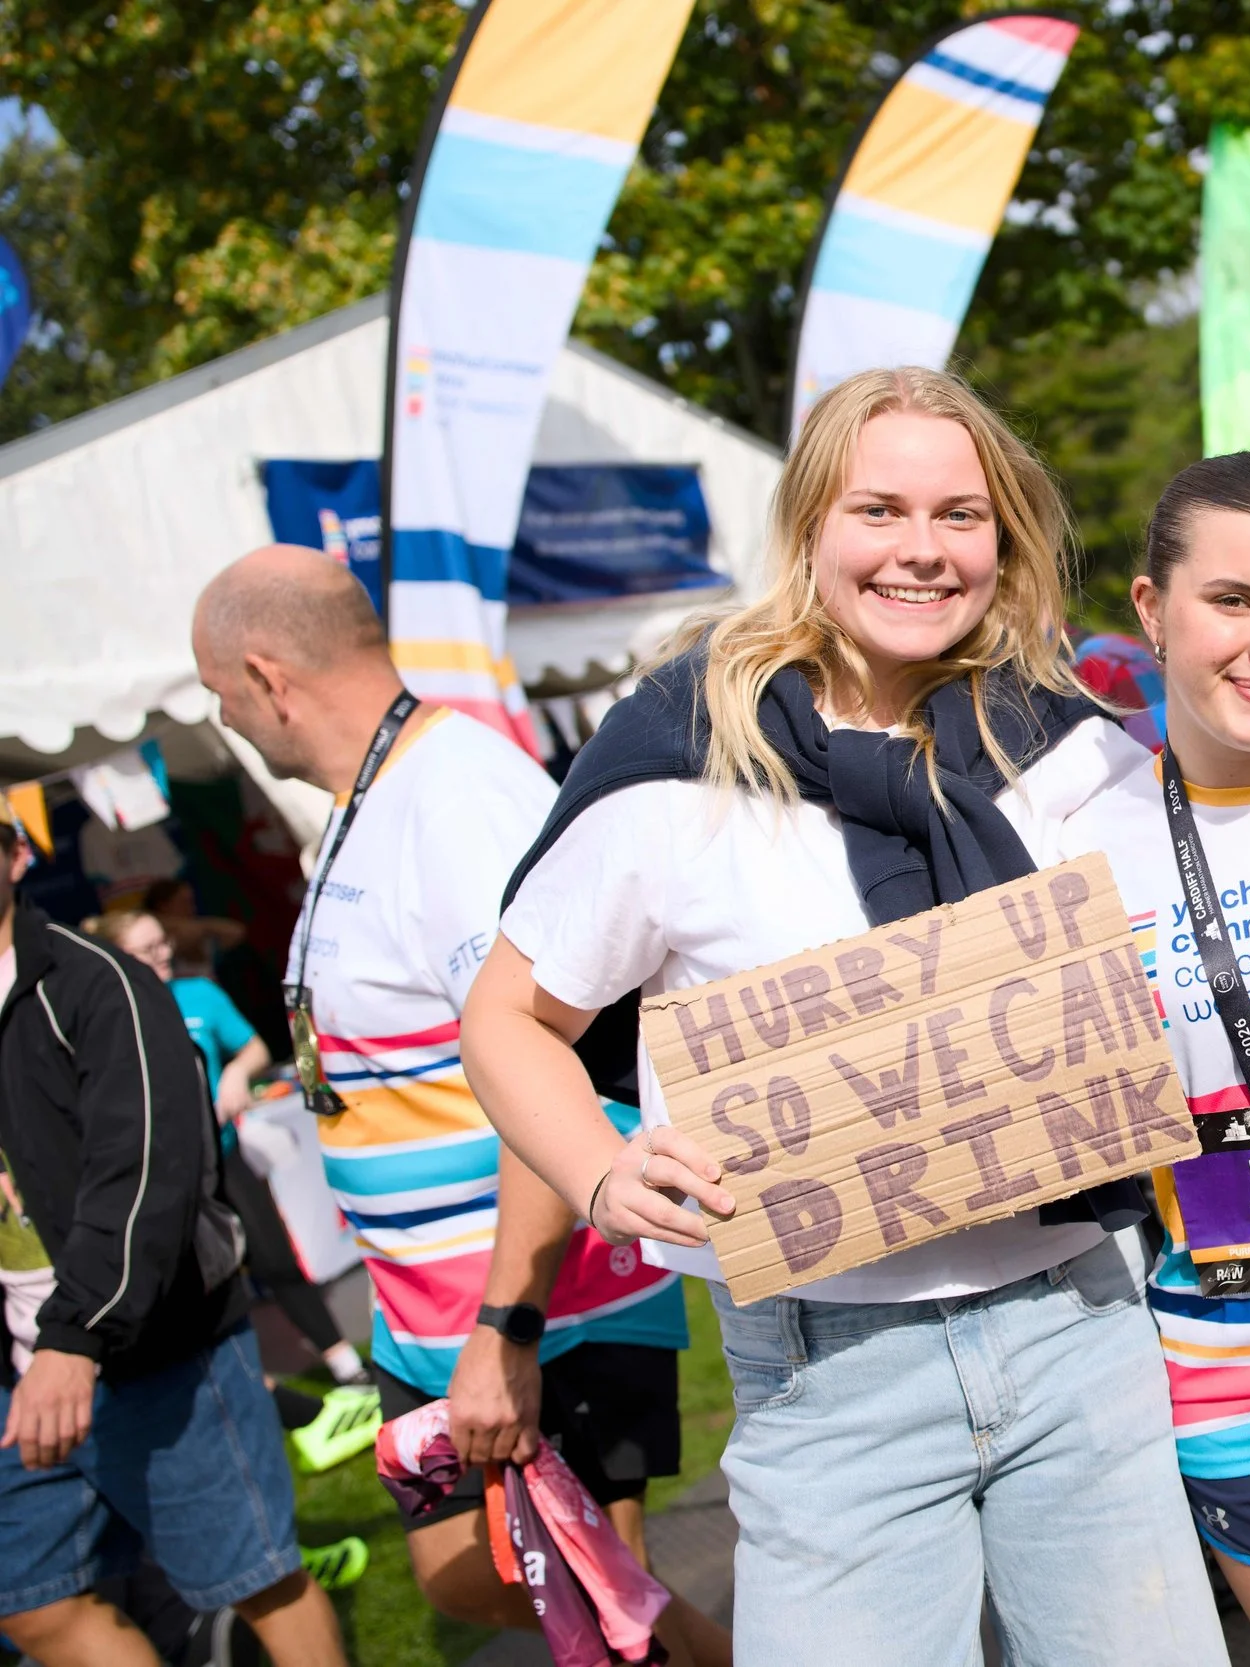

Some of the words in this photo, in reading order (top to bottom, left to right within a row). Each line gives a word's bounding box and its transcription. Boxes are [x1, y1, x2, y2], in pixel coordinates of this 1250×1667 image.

[1167, 779, 1183, 815] 2026
[1177, 839, 1193, 871] HALF
[1195, 861, 1208, 892] MARATHON
[1185, 871, 1207, 920] CARDIFF
[674, 918, 943, 1074] HURRY
[998, 872, 1091, 960] UP
[710, 1074, 812, 1176] SO
[828, 1008, 988, 1129] WE
[988, 942, 1163, 1083] CAN
[757, 1062, 1196, 1276] DRINK
